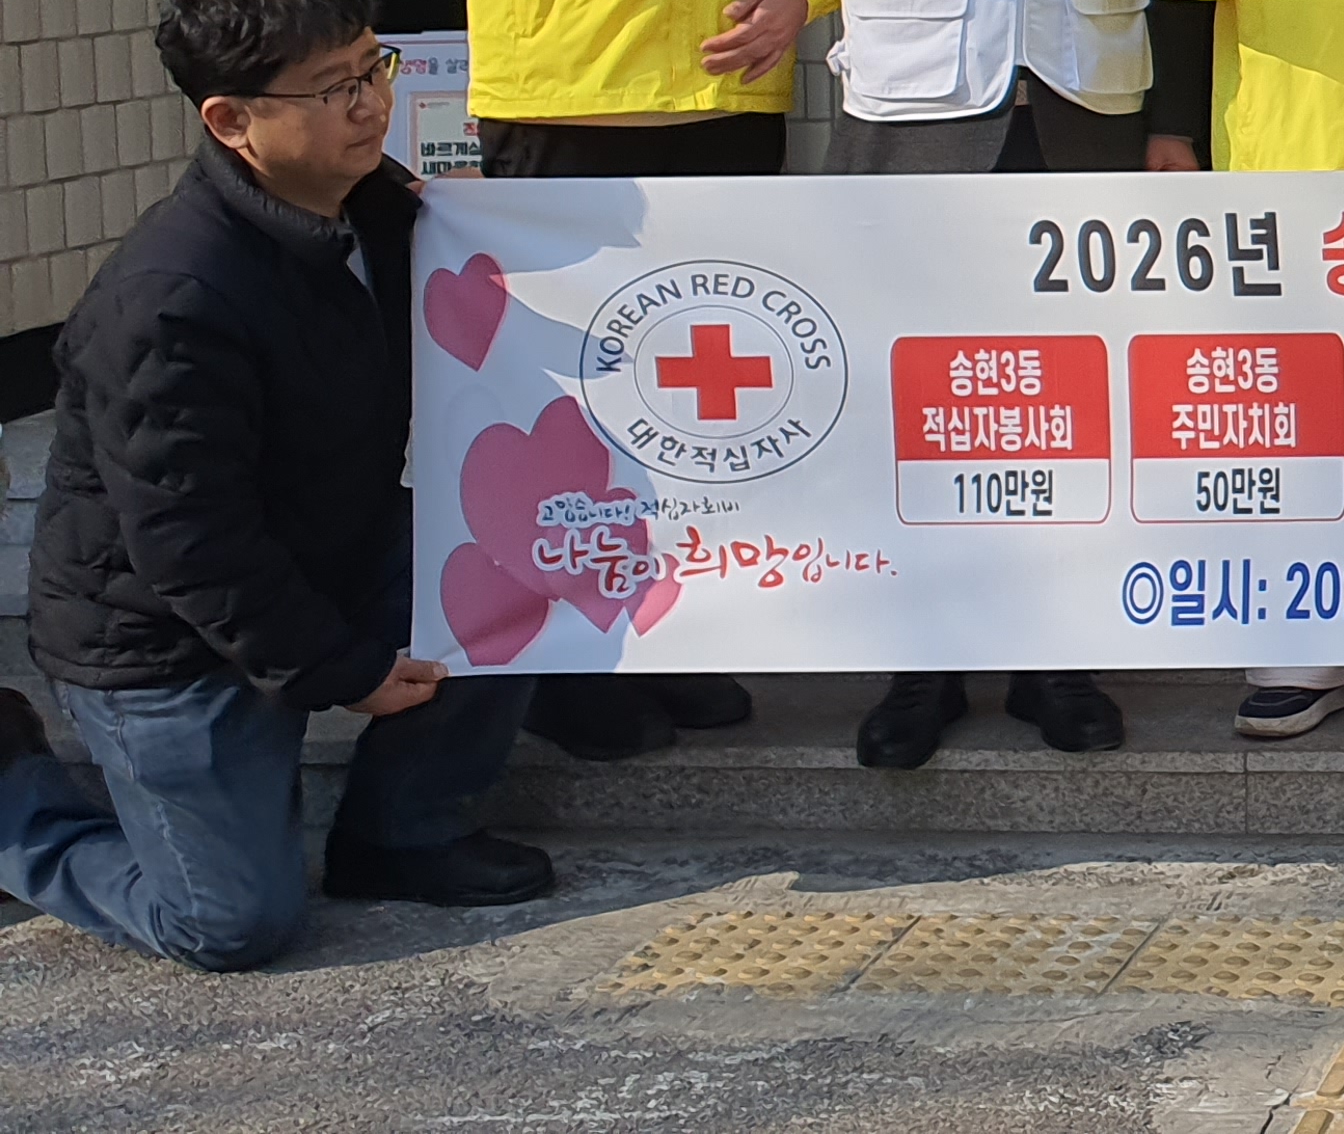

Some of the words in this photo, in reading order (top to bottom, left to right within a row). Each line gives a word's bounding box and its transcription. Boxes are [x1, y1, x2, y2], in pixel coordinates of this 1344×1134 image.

[1029, 212, 1282, 296] 2026년
[596, 277, 684, 374] KOREAN
[691, 273, 756, 299] RED
[760, 288, 832, 371] CROSS
[950, 349, 1041, 396] 송현3동
[1187, 347, 1278, 393] 송현3동
[626, 416, 813, 473] 대한적십자사
[923, 405, 1072, 451] 적십자봉사회
[1172, 402, 1295, 449] 주민자치회
[641, 496, 741, 522] 적십자회비
[954, 470, 1052, 516] 110만원
[1197, 468, 1280, 514] 50만원
[537, 530, 661, 594] 나눔이
